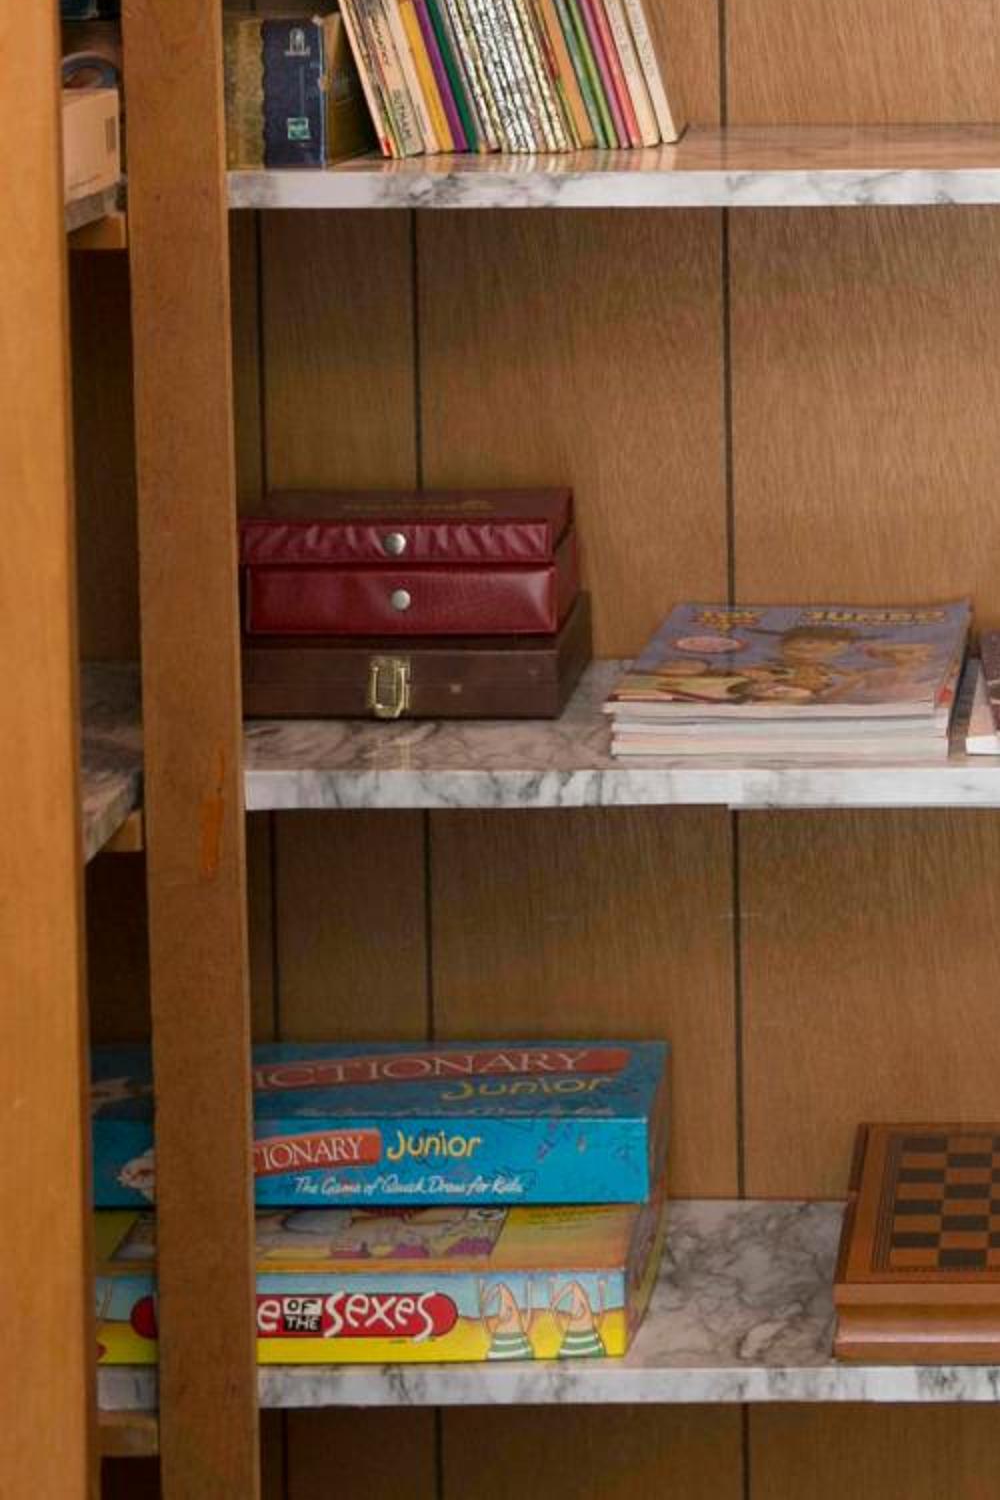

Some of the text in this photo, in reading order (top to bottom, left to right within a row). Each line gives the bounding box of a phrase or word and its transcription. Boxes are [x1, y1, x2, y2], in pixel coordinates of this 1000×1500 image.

[255, 1051, 590, 1089] ICTIONARY
[441, 1076, 613, 1101] Junior
[386, 1130, 482, 1161] Junior
[295, 1175, 317, 1194] The
[321, 1176, 362, 1195] Game
[363, 1175, 379, 1196] of
[465, 1174, 490, 1197] for
[286, 1300, 322, 1315] OF
[323, 1290, 437, 1342] Sexes
[286, 1317, 320, 1331] THE
